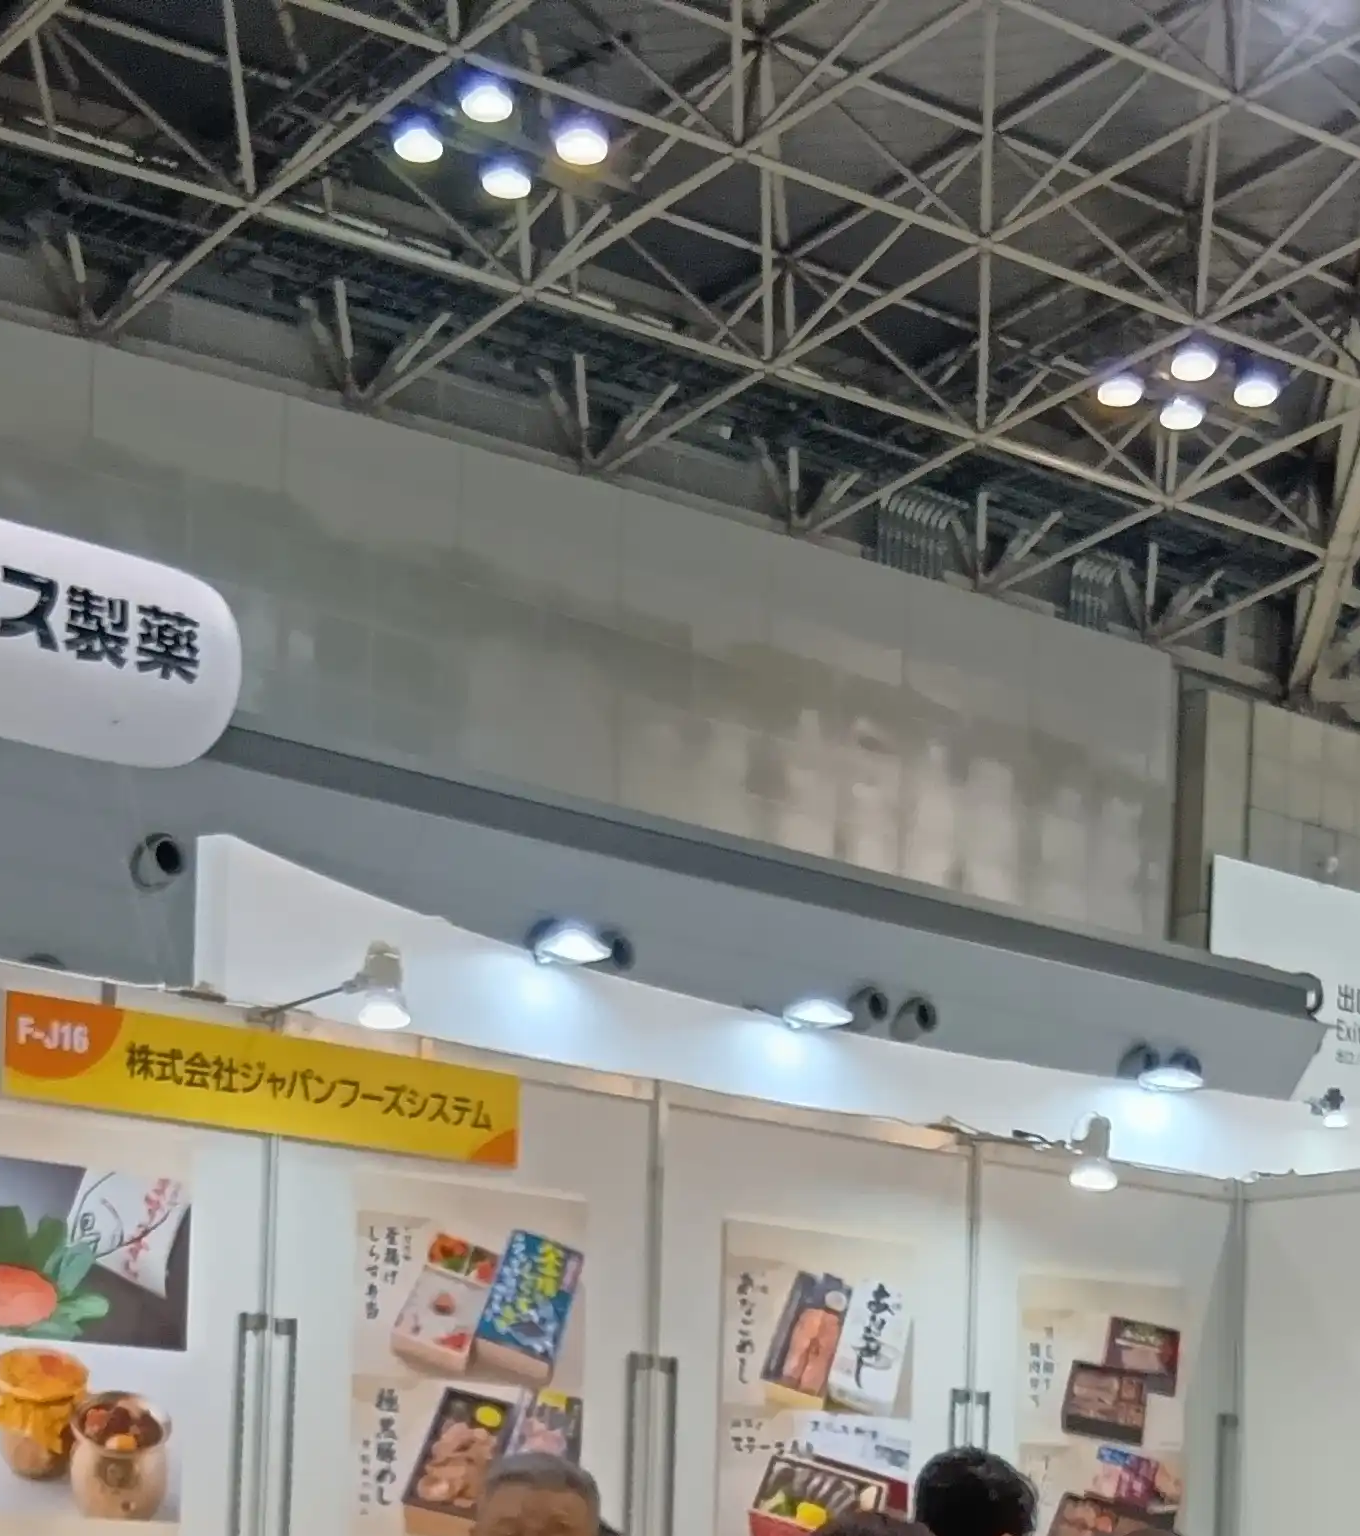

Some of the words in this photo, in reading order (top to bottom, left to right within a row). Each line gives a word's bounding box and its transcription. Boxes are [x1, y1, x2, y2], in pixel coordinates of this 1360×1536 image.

[16, 1015, 89, 1055] F-J16
[125, 1041, 494, 1131] 株式会社ジャパンフーズシステム
